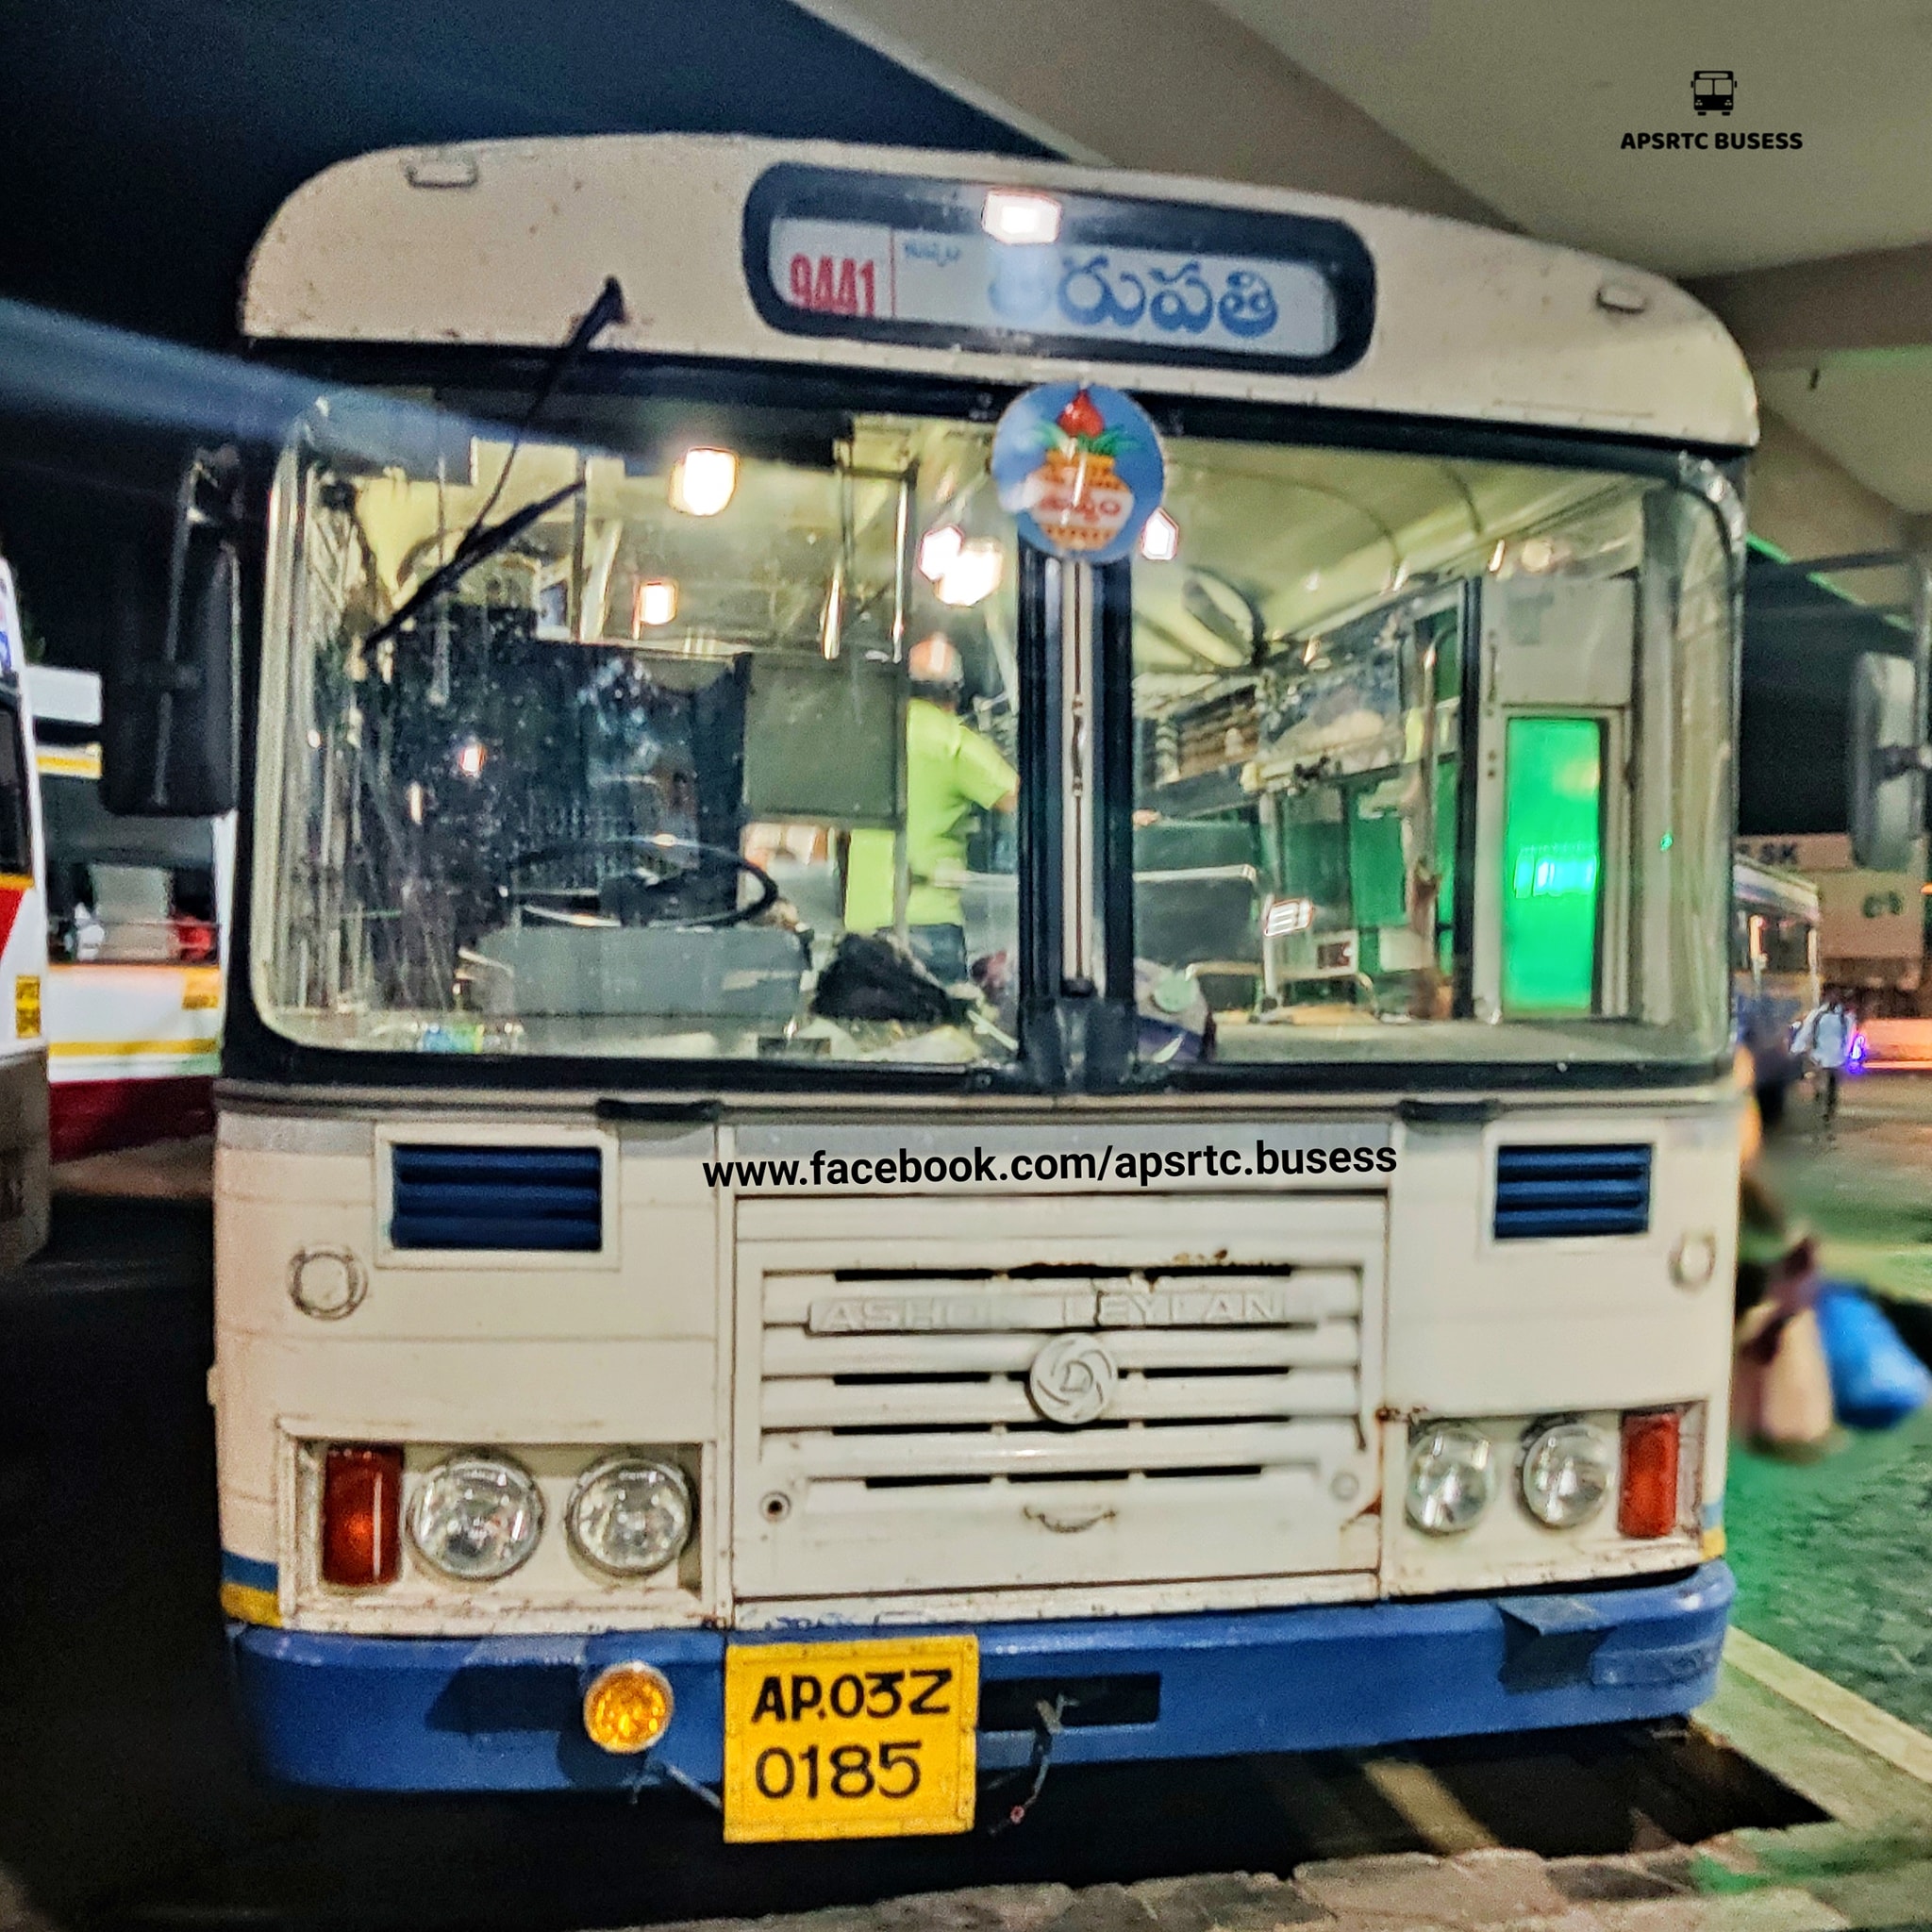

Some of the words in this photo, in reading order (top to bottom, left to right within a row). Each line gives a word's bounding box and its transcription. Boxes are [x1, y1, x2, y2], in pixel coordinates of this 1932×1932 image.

[791, 253, 875, 317] 9441
[987, 253, 1280, 339] రుపతి
[822, 1296, 1024, 1331] ASHO
[1060, 1289, 1313, 1326] LEYLAN
[755, 1740, 923, 1800] 0185
